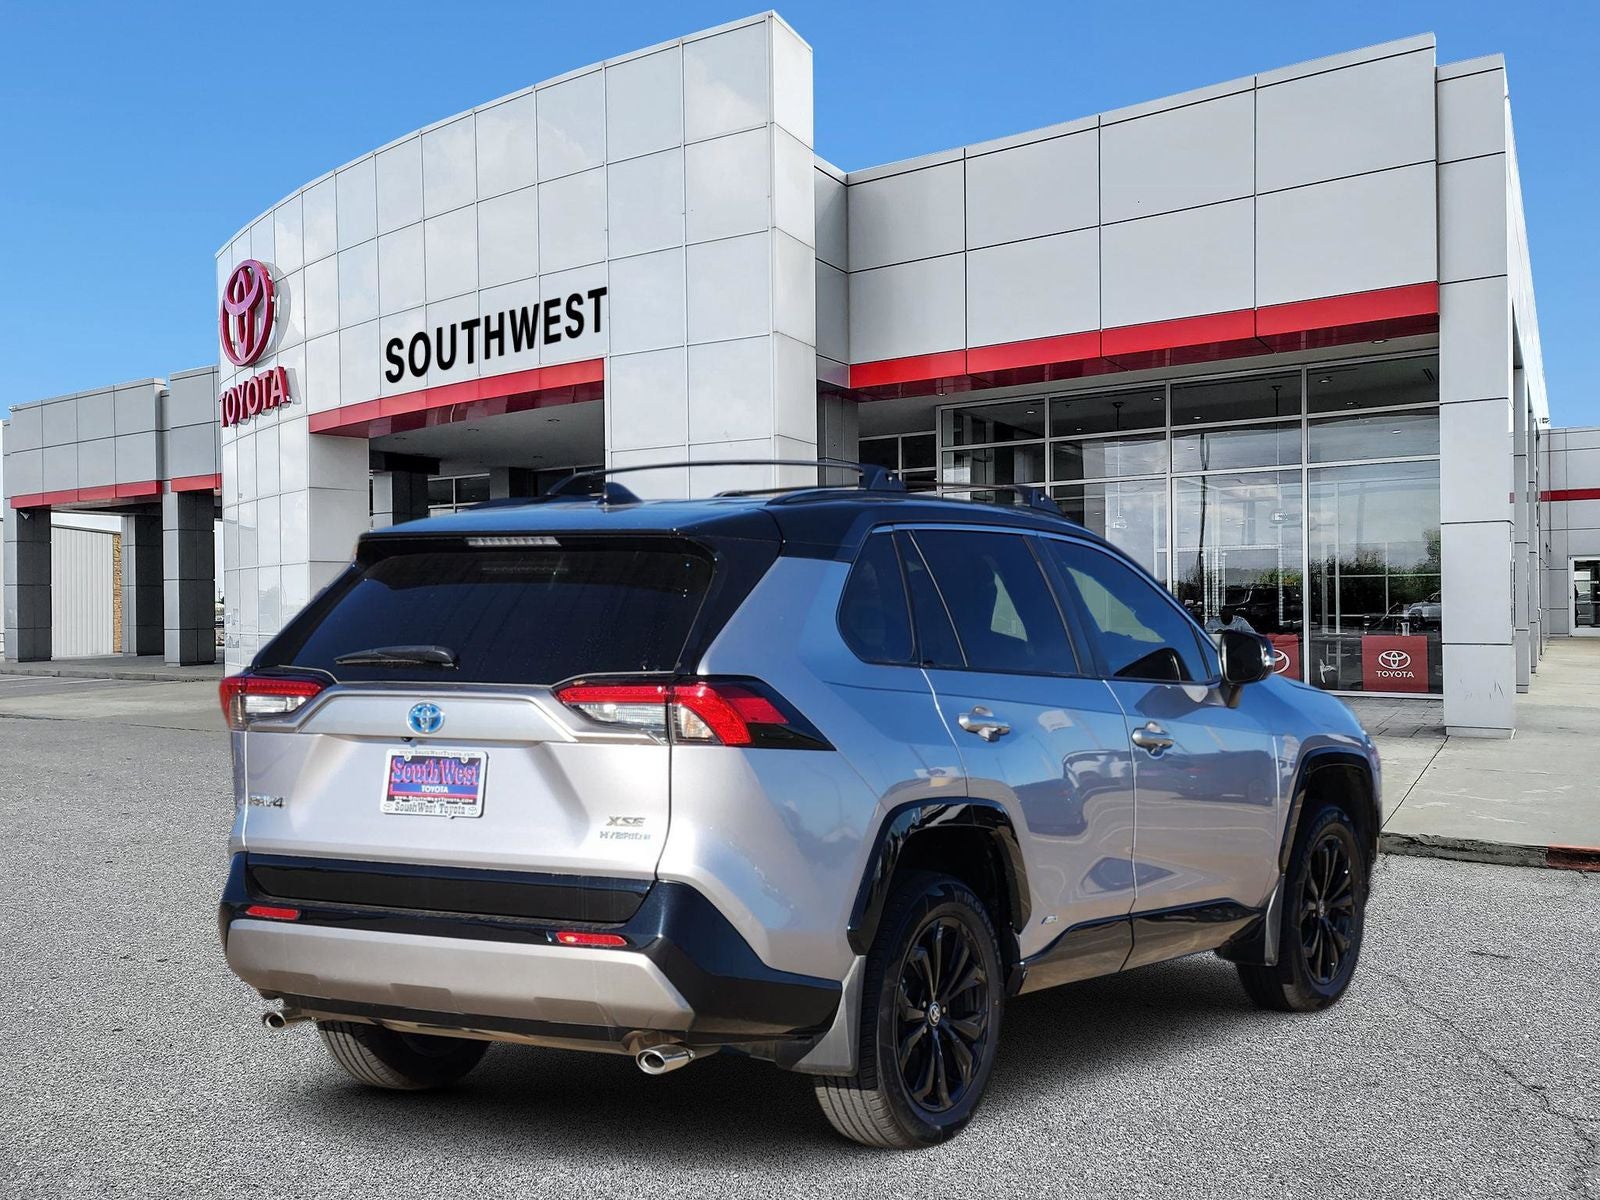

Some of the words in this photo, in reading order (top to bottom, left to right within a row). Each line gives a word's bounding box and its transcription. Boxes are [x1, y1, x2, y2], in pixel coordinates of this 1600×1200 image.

[385, 286, 608, 384] SOUTHWEST
[219, 366, 292, 428] TOYOTA
[1376, 670, 1414, 678] TOYOTA
[421, 785, 448, 793] TOYOTA
[394, 802, 437, 813] SouthWest
[439, 803, 466, 816] Toyota
[606, 815, 646, 827] XSE
